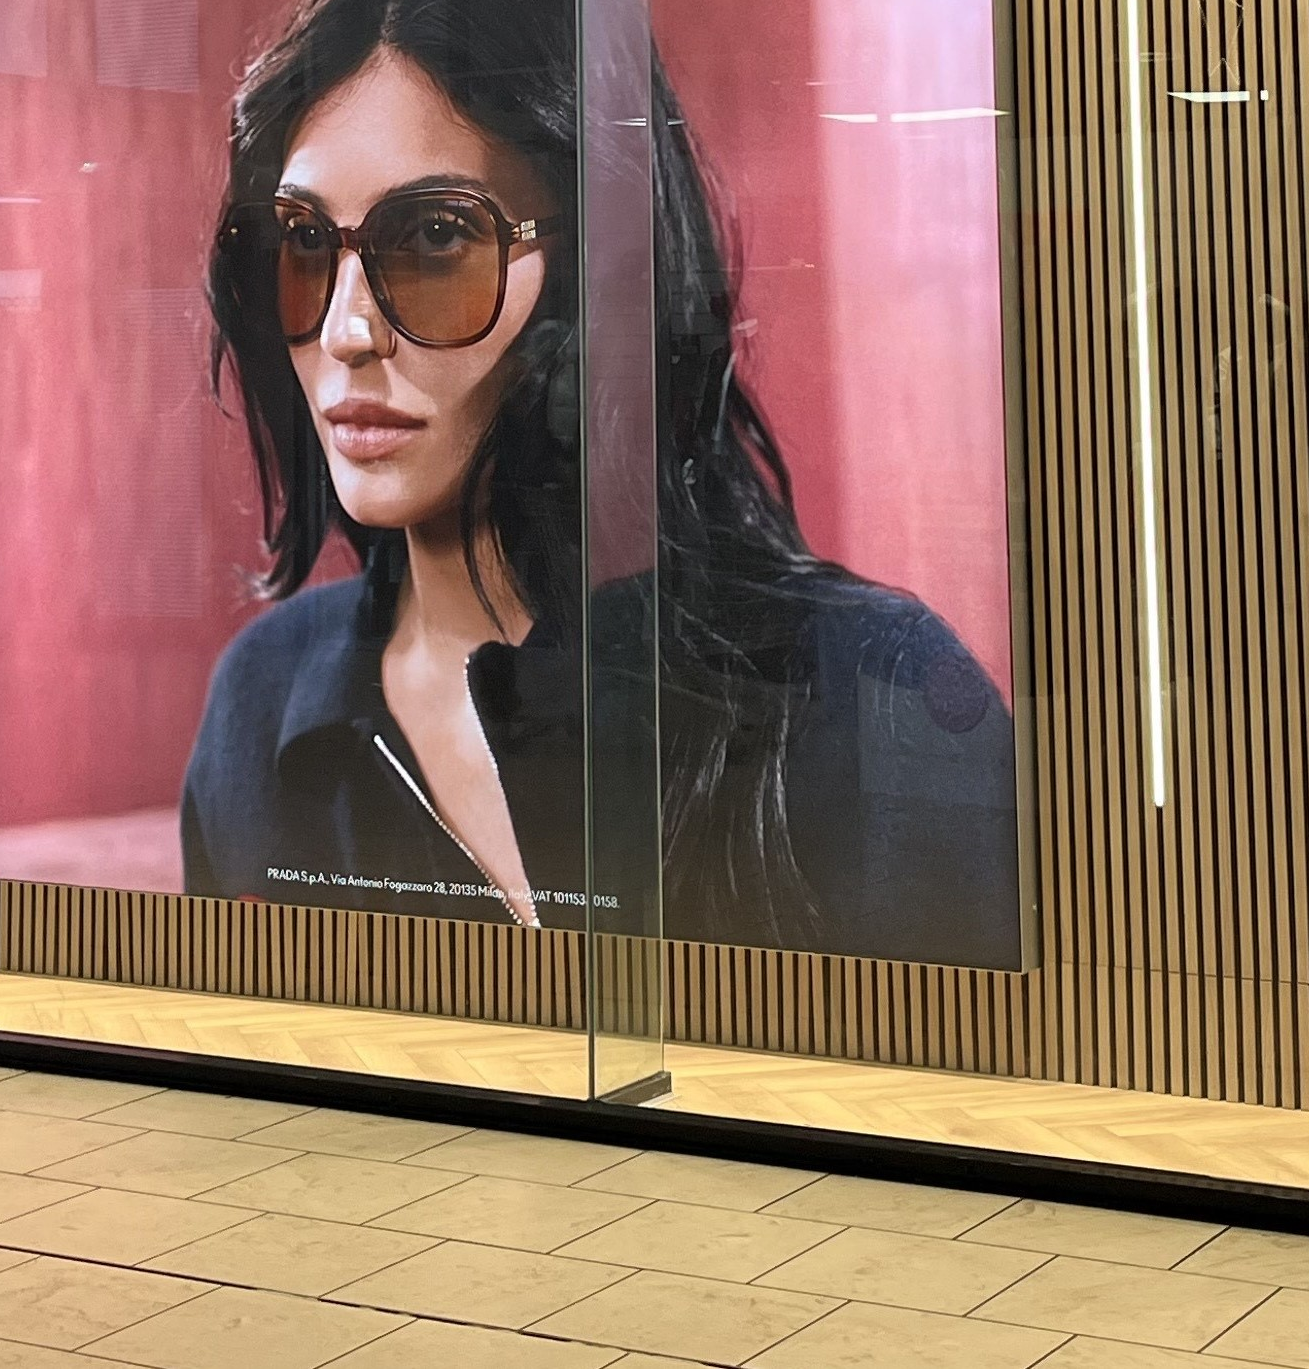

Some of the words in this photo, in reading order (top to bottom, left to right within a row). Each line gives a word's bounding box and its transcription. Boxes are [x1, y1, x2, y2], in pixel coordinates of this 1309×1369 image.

[267, 867, 300, 881] PRADA
[330, 873, 347, 886] Via
[347, 875, 384, 889] Antonio
[383, 877, 433, 893] Fogazzaro
[433, 881, 448, 895] 28,
[449, 882, 477, 897] 20135
[532, 890, 552, 903] VAT
[553, 891, 621, 909] 1011530158.
